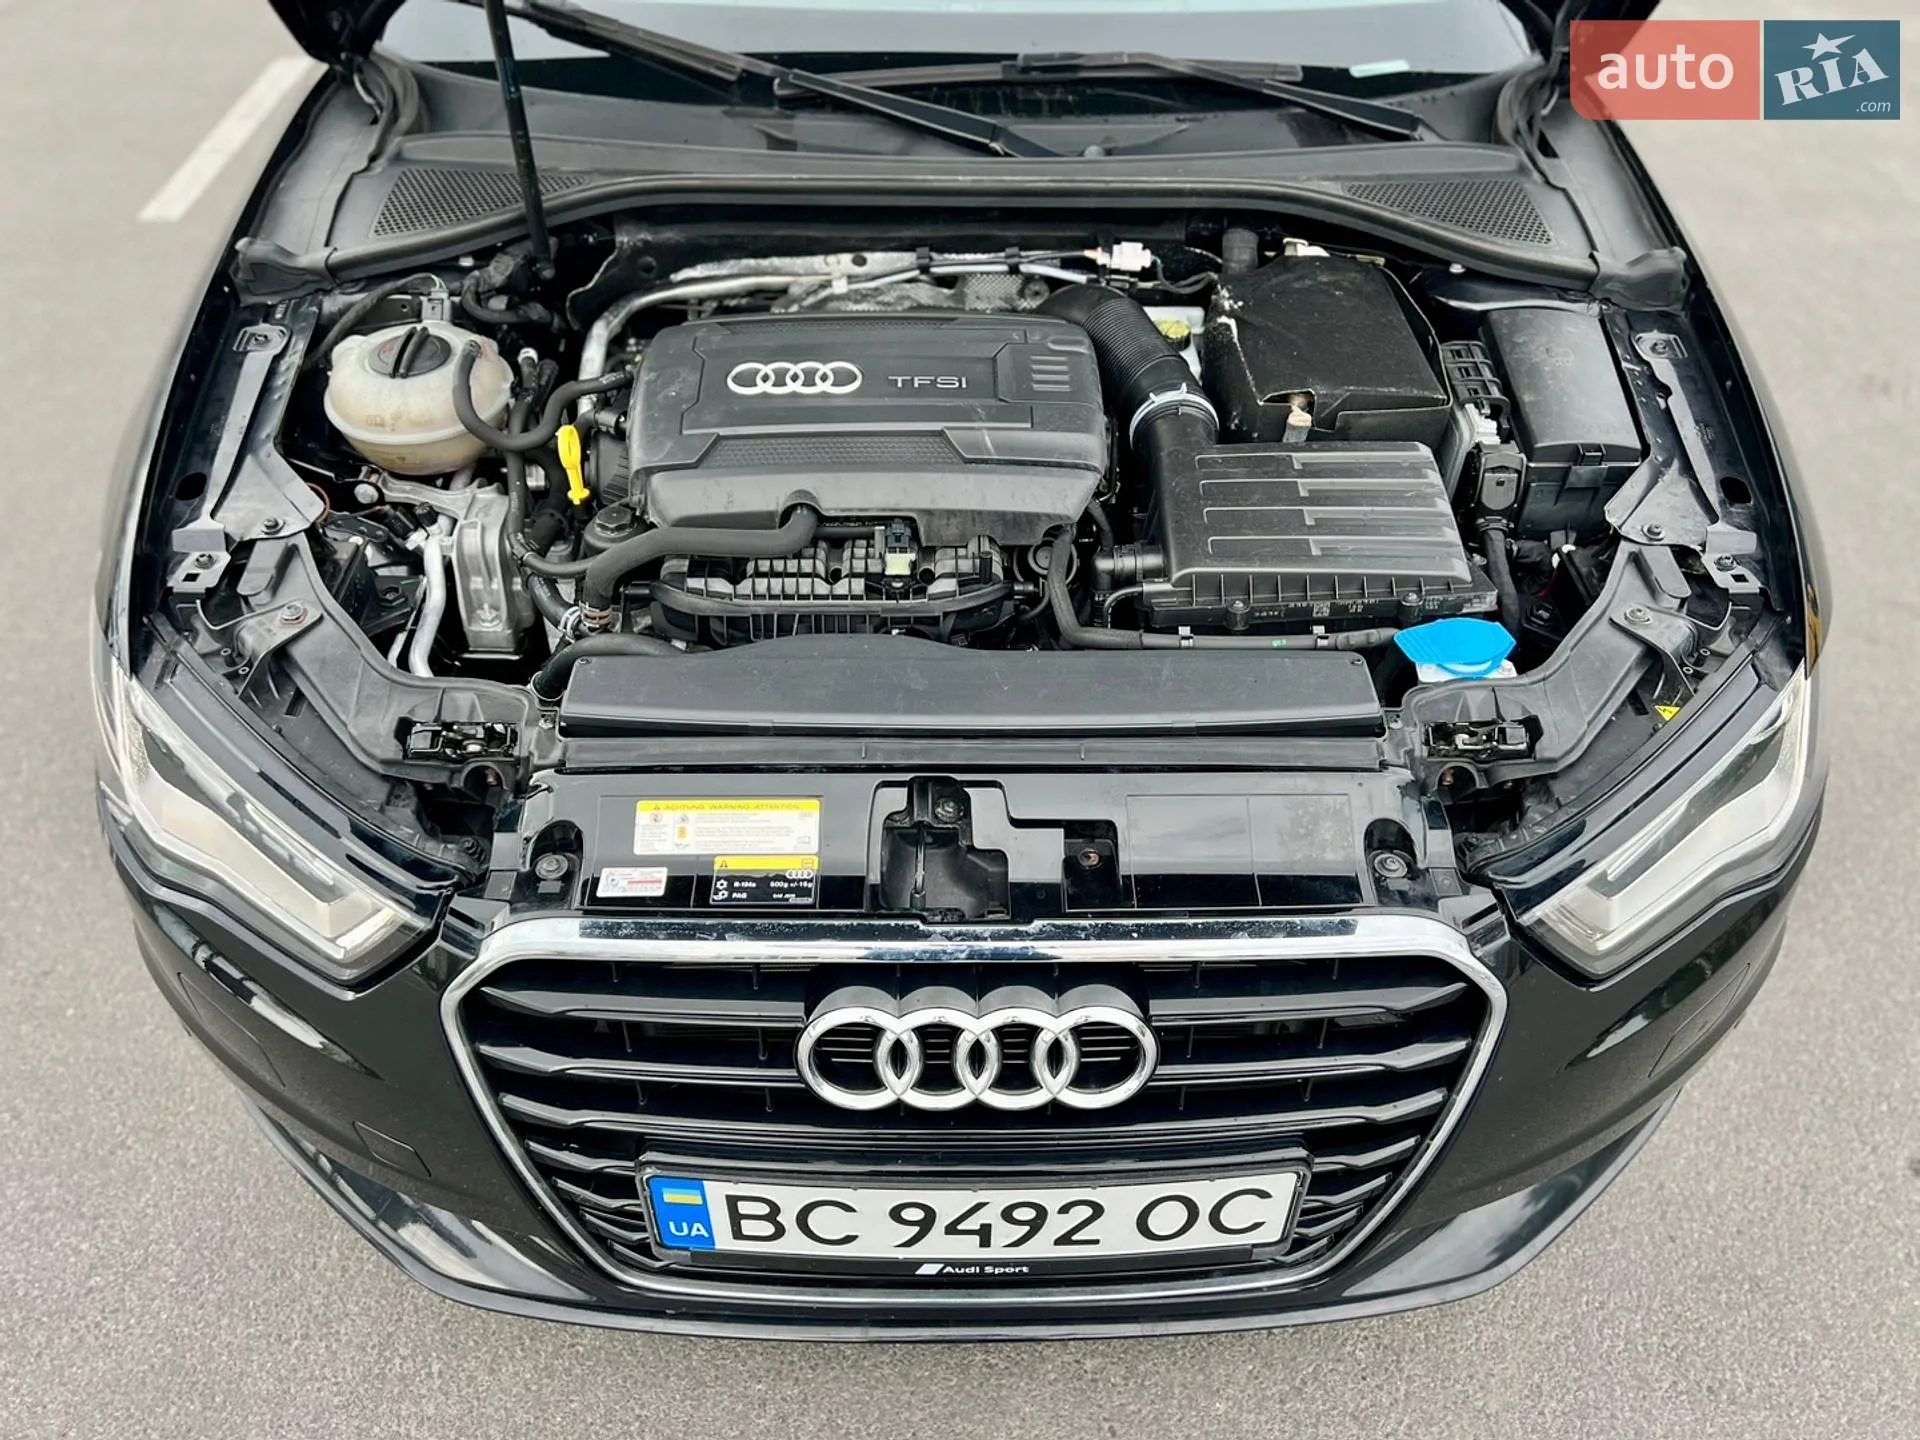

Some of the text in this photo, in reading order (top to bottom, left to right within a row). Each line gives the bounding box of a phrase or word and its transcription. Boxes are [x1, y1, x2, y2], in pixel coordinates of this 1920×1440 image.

[888, 376, 967, 388] TFSI
[708, 803, 750, 811] WARNING
[753, 803, 800, 811] ATTENTION
[668, 1188, 1273, 1248] UA BC 9492 OC
[942, 1265, 1030, 1275] Audi Sport
